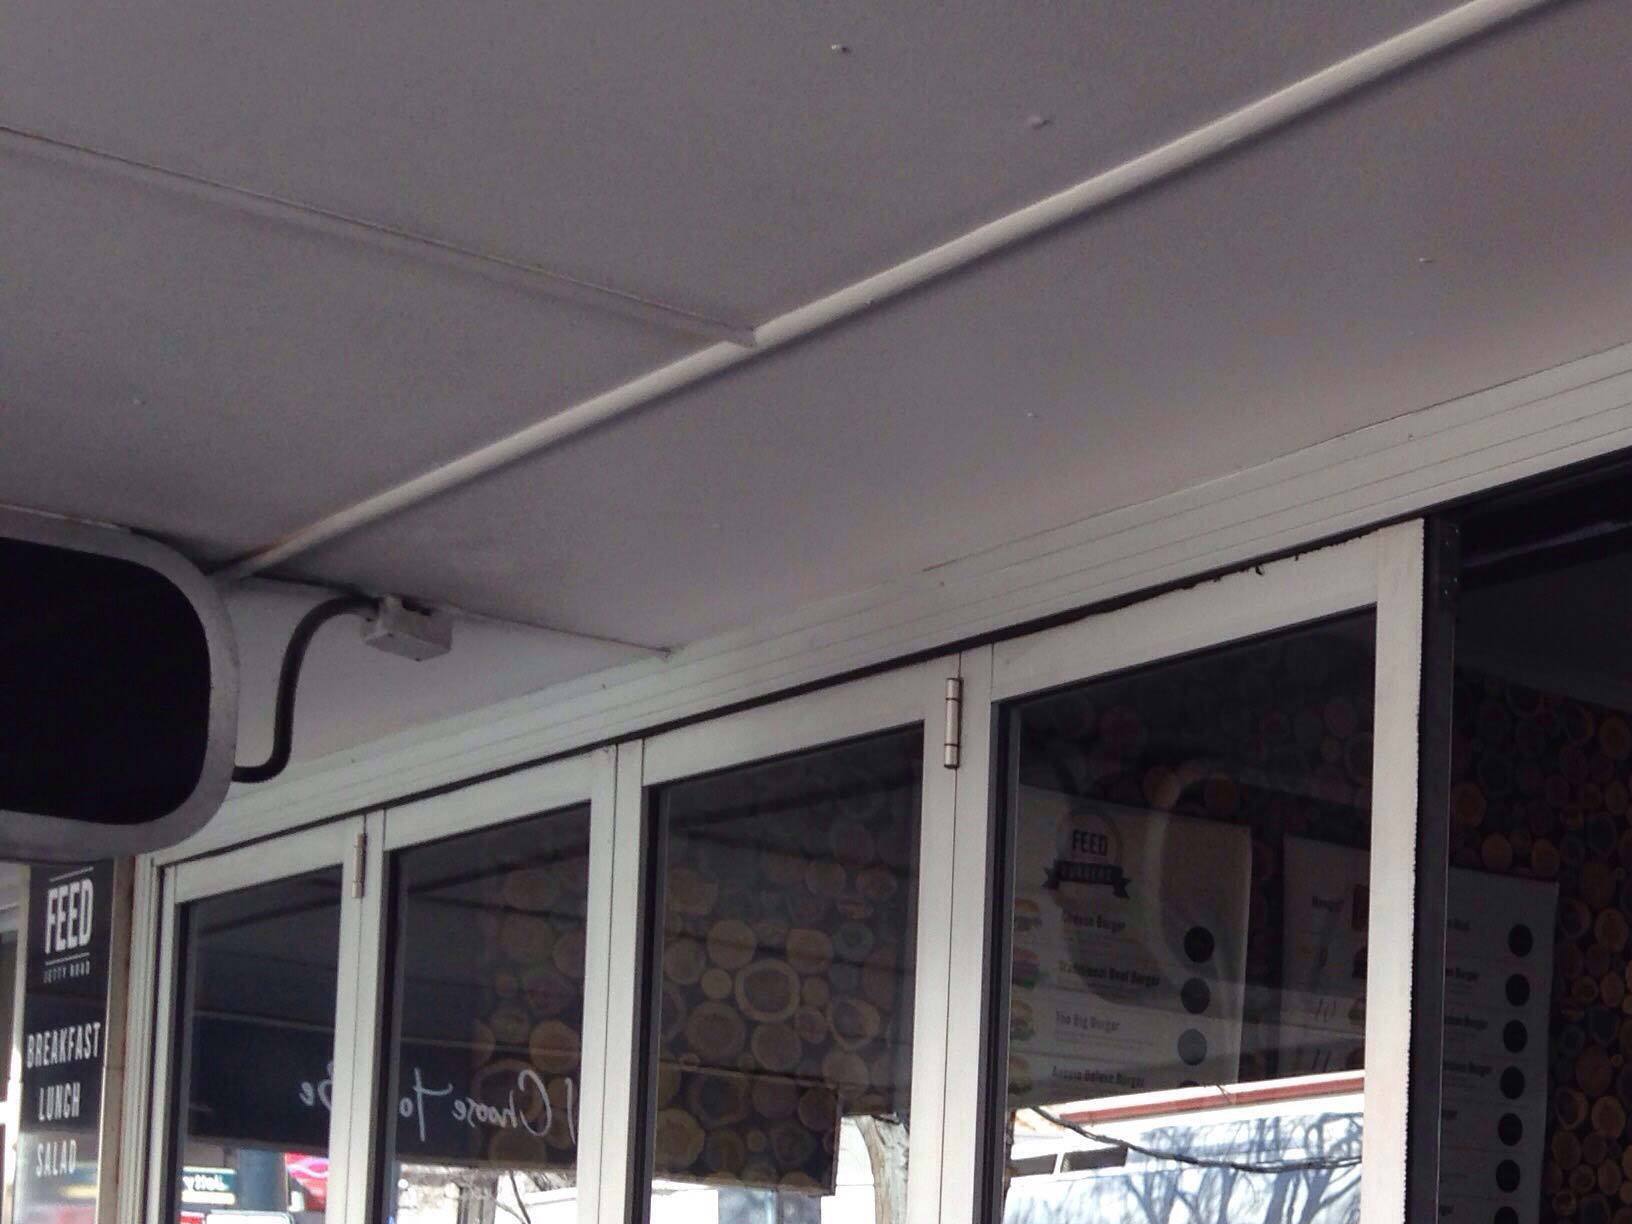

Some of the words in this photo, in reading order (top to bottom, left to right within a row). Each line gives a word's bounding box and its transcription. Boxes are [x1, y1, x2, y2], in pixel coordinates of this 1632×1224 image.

[45, 878, 94, 955] FEED
[27, 1022, 100, 1069] BREAKFAST
[39, 1082, 80, 1121] LUNCH
[36, 1140, 76, 1178] SALAD
